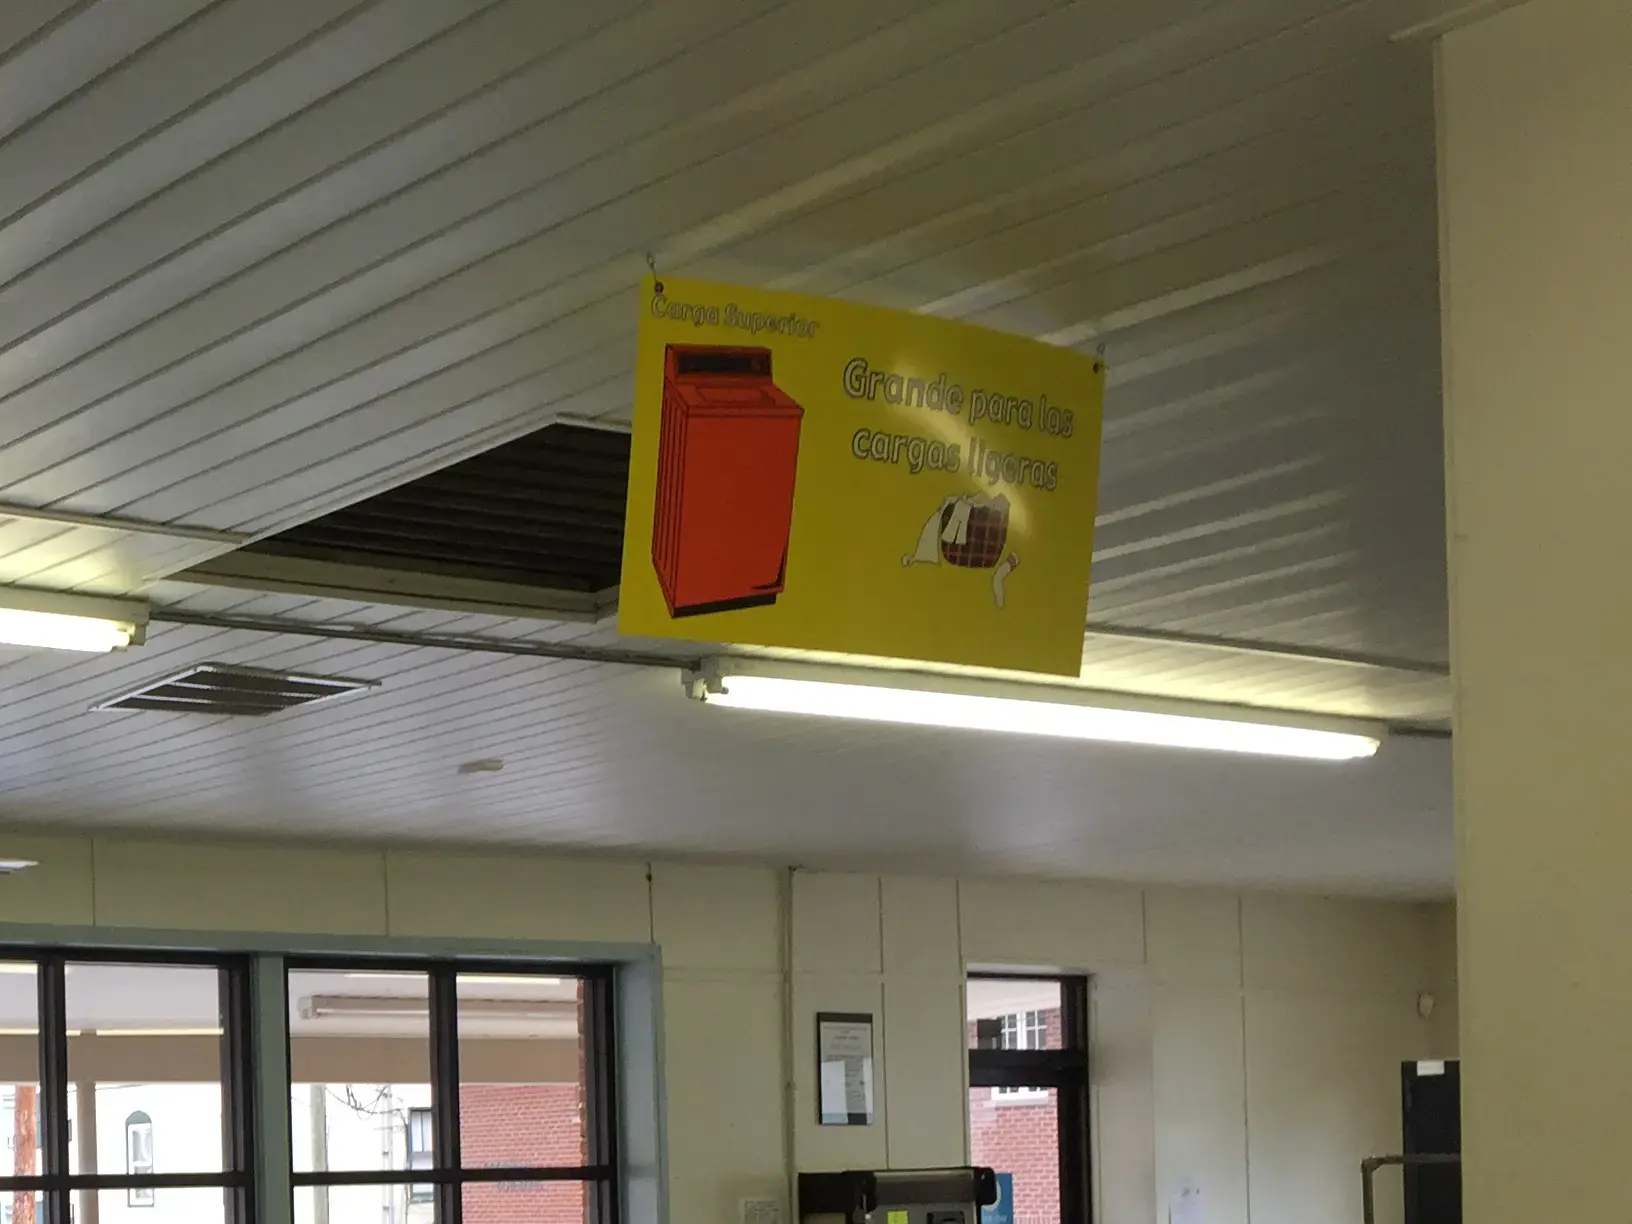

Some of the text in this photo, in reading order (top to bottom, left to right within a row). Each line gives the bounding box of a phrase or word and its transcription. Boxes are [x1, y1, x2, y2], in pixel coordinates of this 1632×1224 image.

[650, 294, 820, 339] Carga Superior
[843, 357, 1075, 438] Grande para las
[852, 428, 1059, 493] cargas ligeras
